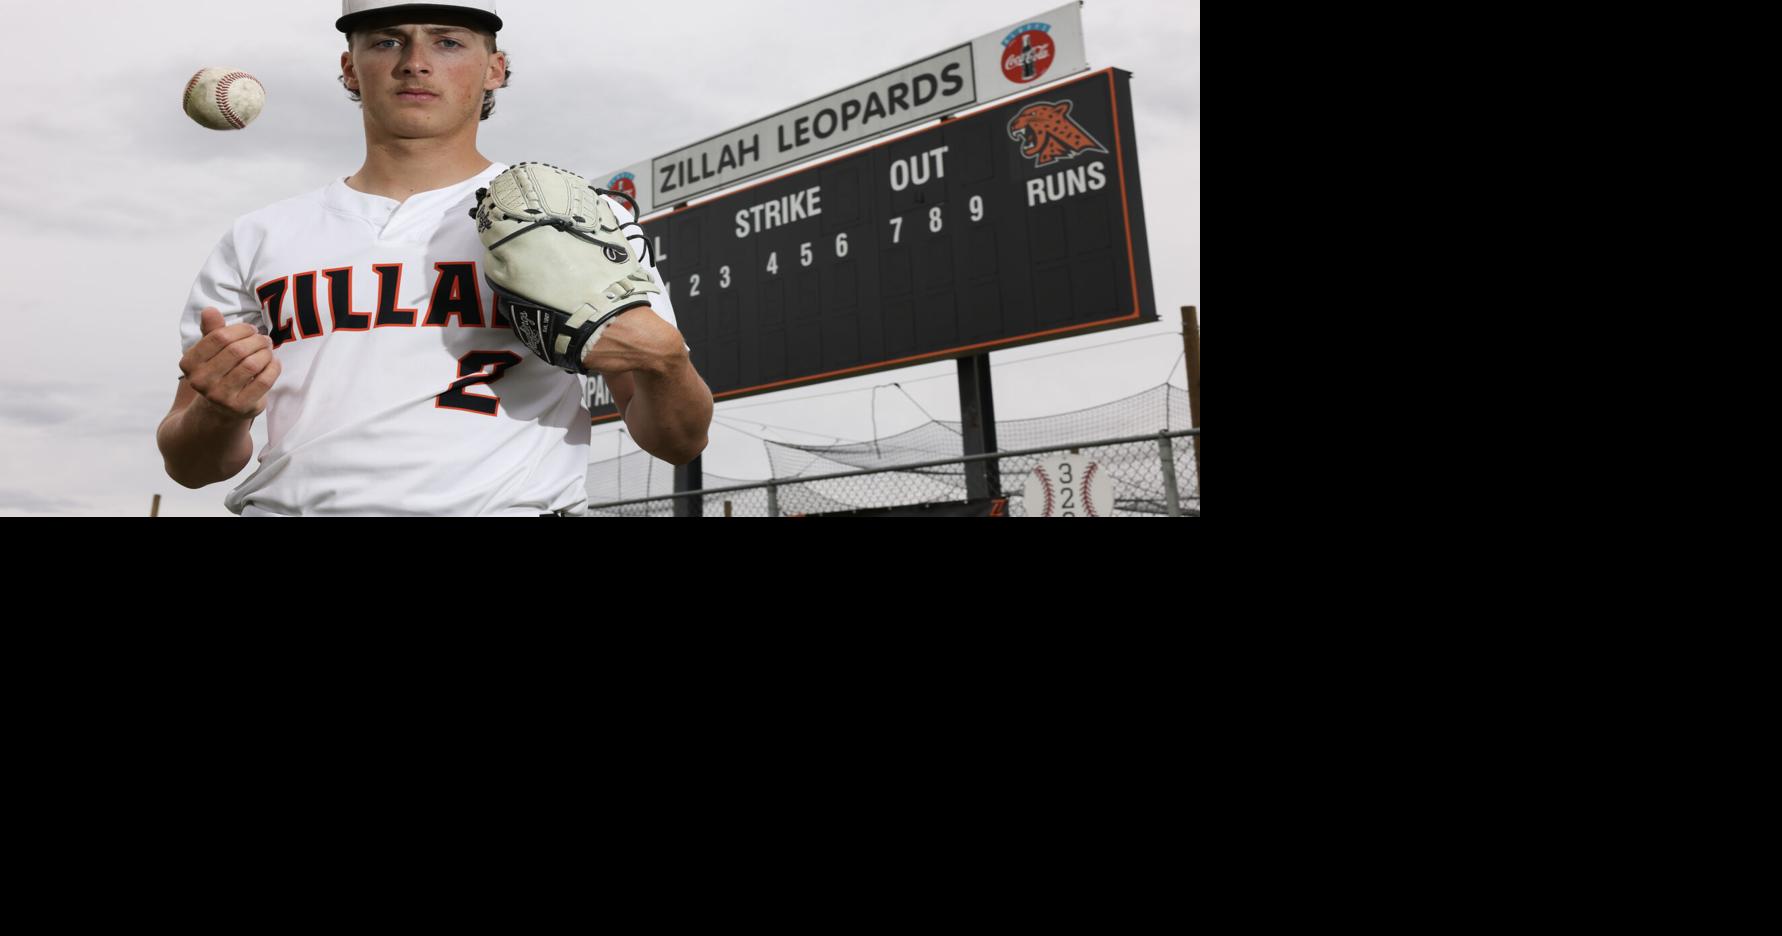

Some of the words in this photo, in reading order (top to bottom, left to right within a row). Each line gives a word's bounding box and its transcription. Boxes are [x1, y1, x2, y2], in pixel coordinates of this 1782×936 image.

[660, 134, 759, 193] ZILLAH
[777, 62, 964, 153] LEOPARDS
[735, 186, 822, 238] STRIKE
[890, 146, 948, 191] OUT
[1026, 161, 1106, 207] RUNS
[690, 274, 700, 297] 2
[720, 265, 730, 288] 3
[766, 252, 778, 274] 4
[800, 242, 813, 267] 5
[835, 233, 848, 257] 6
[889, 217, 903, 243] 7
[929, 207, 942, 232] 8
[969, 195, 984, 222] 9
[256, 261, 514, 349] ZILLA
[435, 350, 523, 416] 2
